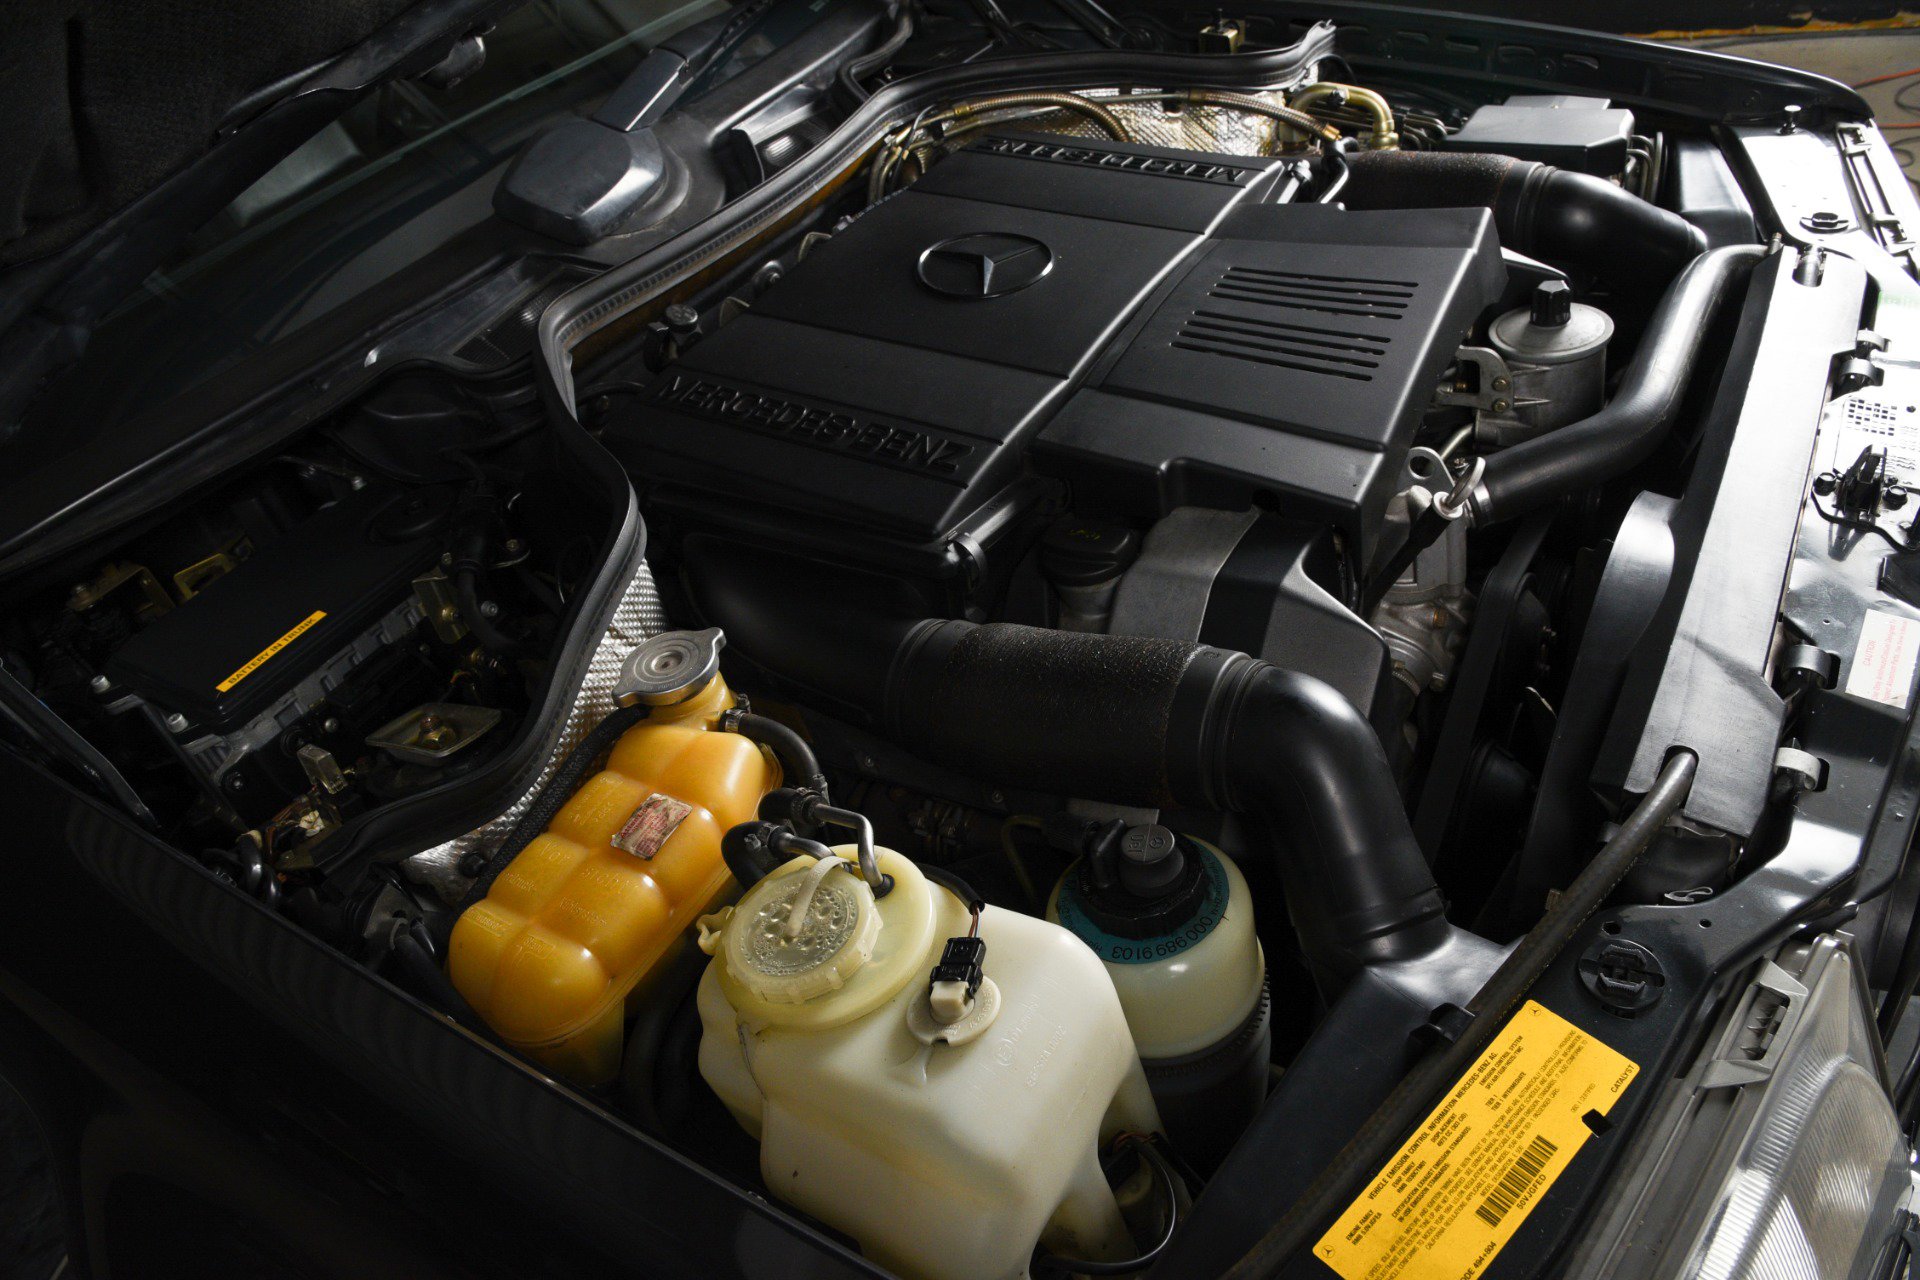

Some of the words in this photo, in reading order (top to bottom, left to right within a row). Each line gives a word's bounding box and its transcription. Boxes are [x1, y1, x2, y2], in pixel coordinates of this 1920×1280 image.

[988, 139, 1245, 182] MERCEDES-BENZ
[658, 375, 975, 472] MERCEDES-BENZ
[228, 652, 269, 684] BATTERY
[271, 642, 282, 652] IN
[283, 618, 313, 642] TRUNK
[1187, 915, 1213, 941] 000
[1112, 946, 1153, 960] 9103
[1156, 936, 1187, 959] 989
[1479, 1067, 1496, 1085] EMISSION
[1495, 1050, 1511, 1067] CONTROL
[1509, 1035, 1523, 1051] SYSTEM
[1491, 1101, 1501, 1111] TIER
[1502, 1072, 1526, 1099] INTERMEDIATE
[1611, 1064, 1635, 1093] CATALYST
[1486, 1097, 1495, 1107] TIER
[1368, 1178, 1388, 1200] VEHICLE
[1386, 1153, 1410, 1178] EMISSION
[1407, 1131, 1429, 1154] CONTROL
[1427, 1098, 1457, 1131] INFORMATION
[1455, 1060, 1490, 1098] MERCEDES-BENZ
[1430, 1113, 1457, 1142] DISPLACEMENT
[1392, 1175, 1403, 1187] EVAP
[1401, 1161, 1415, 1176] FAMILY
[1392, 1187, 1419, 1217] CERTIFICATION
[1417, 1169, 1435, 1188] EXHAUST
[1432, 1149, 1451, 1169] EMISSION
[1398, 1207, 1412, 1222] IN-USE
[1410, 1187, 1429, 1208] EMISSION
[1516, 1174, 1547, 1209] 50VJGFED
[1346, 1224, 1361, 1240] ENGINE
[1359, 1209, 1374, 1225] FAMILY
[1472, 1241, 1497, 1269] 494+804
